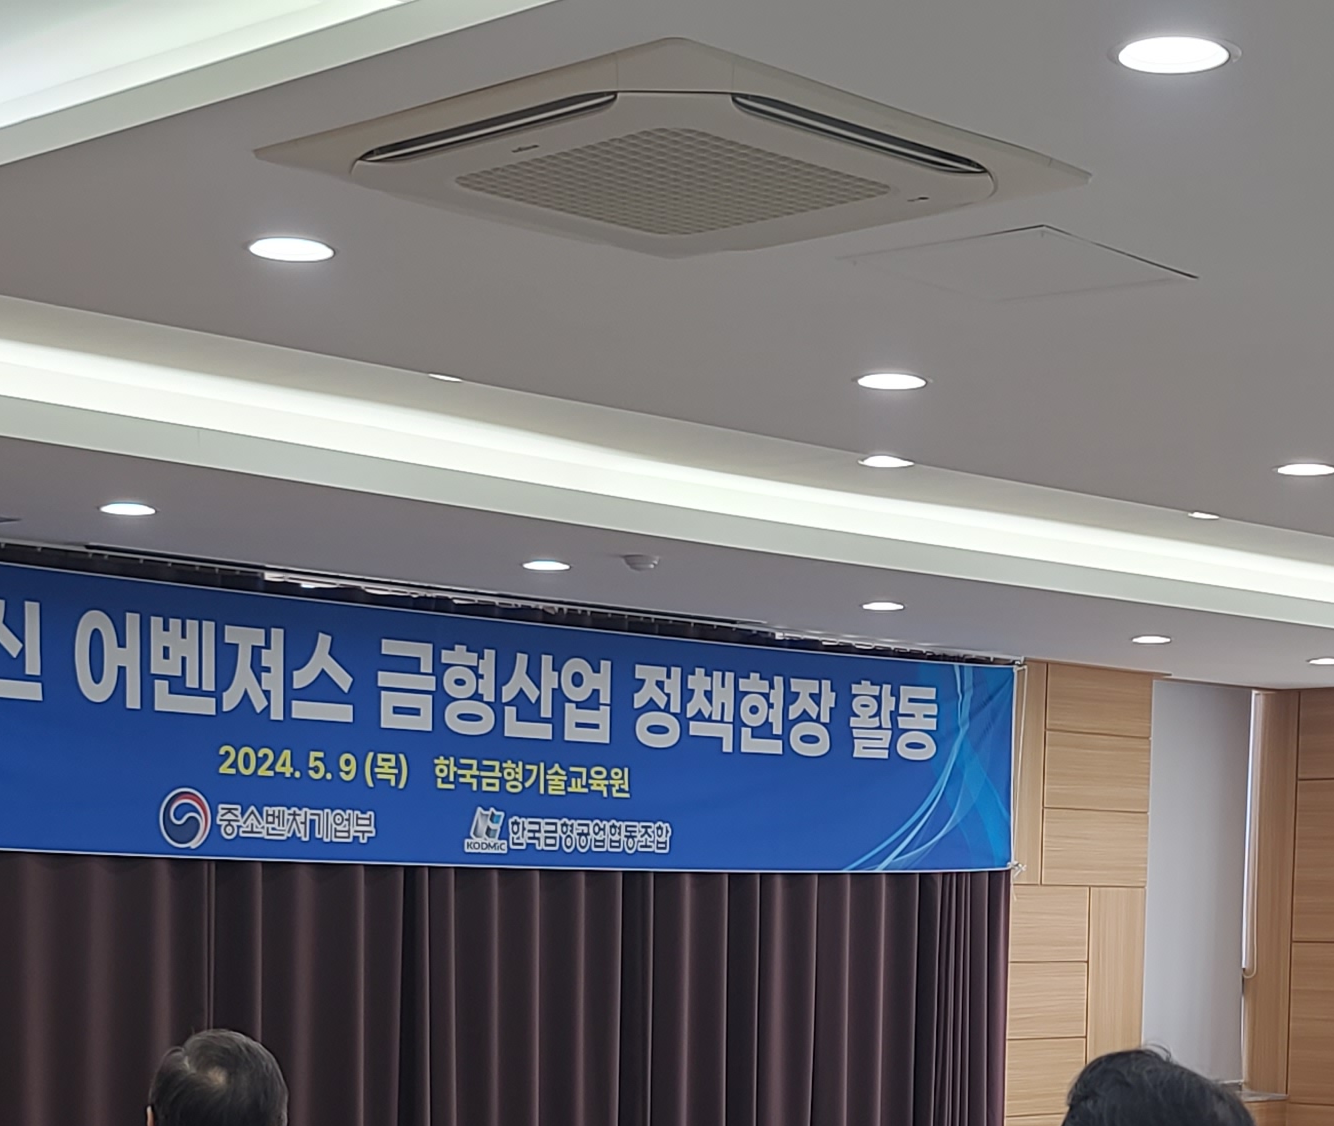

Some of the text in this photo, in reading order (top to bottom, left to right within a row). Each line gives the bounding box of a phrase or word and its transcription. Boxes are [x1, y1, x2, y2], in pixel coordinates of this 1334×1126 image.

[75, 610, 354, 721] 어벤져스
[378, 638, 612, 744] 금형산업
[633, 664, 836, 757] 정책현장
[849, 680, 938, 761] 활동
[219, 744, 631, 798] 2024. 5. 9 (목) 한국금형기술교육원
[217, 804, 376, 843] 중소벤처기업부
[509, 816, 672, 853] 한국금형공업협동조합
